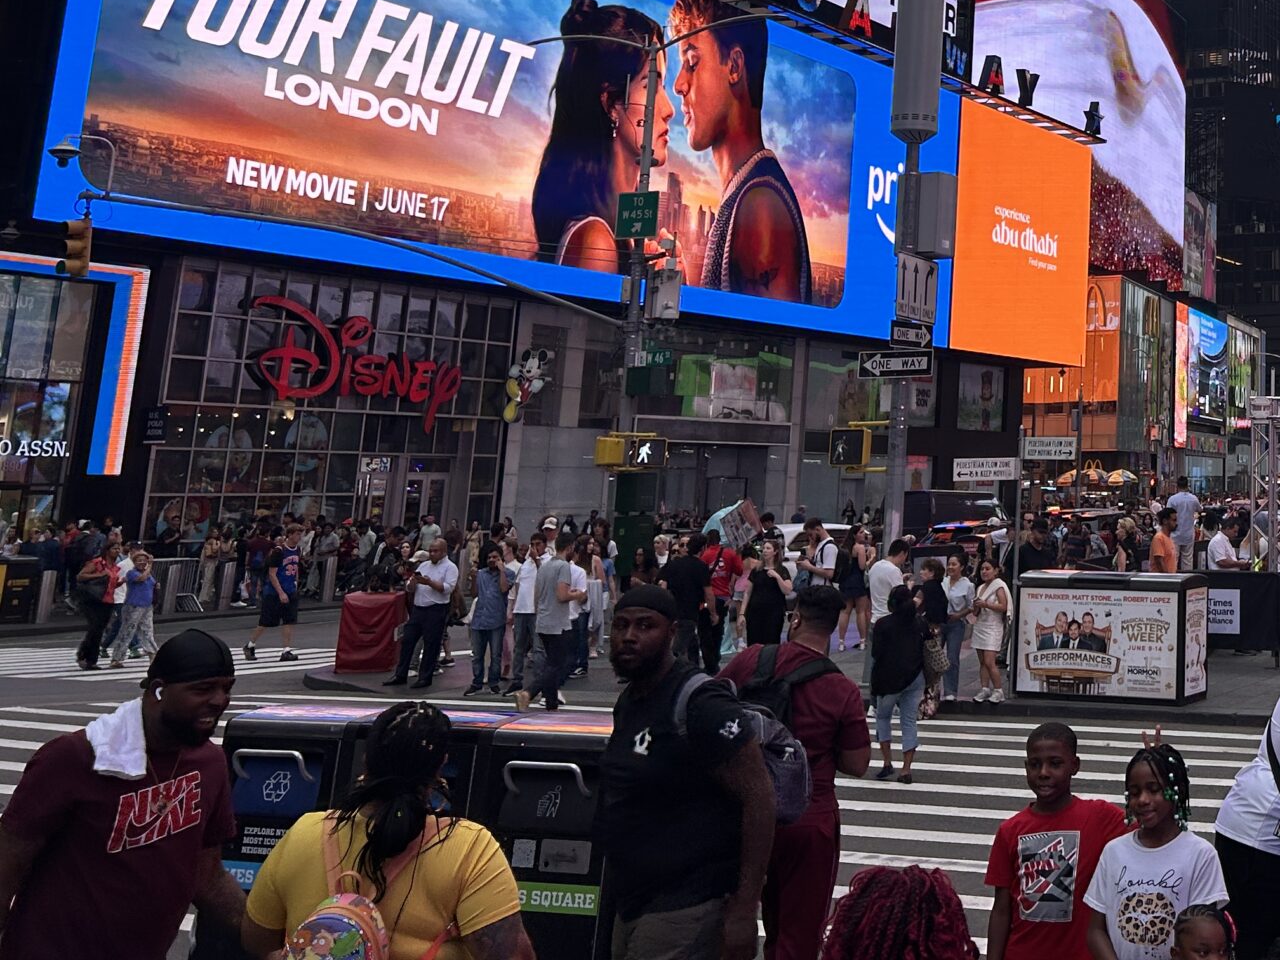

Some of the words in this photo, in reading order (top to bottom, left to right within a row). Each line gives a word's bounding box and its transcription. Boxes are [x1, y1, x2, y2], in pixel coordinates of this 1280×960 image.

[263, 66, 440, 136] LONDON
[225, 156, 285, 191] NEW
[284, 168, 358, 207] MOVIE
[374, 187, 427, 219] JUNE
[429, 195, 450, 222] 17
[633, 197, 644, 207] TO
[630, 210, 643, 219] 45
[994, 204, 1031, 225] experience
[992, 220, 1019, 248] abu
[896, 329, 910, 340] ONE
[914, 329, 928, 341] WAY
[654, 352, 664, 364] 46
[870, 359, 892, 371] ONE
[901, 358, 924, 370] WAY
[15, 440, 70, 458] ASSN.
[1028, 440, 1052, 448] PEDESTRIAN
[1052, 440, 1063, 448] FLOW
[1063, 440, 1074, 448] ZONE
[956, 461, 984, 469] PEDESTRIAN
[985, 461, 998, 469] FLOW
[998, 460, 1011, 468] ZONE
[1027, 593, 1044, 601] TREY
[1123, 595, 1148, 603] ROBERT
[1149, 596, 1171, 604] LOPEZ
[1207, 598, 1233, 607] Times
[1207, 607, 1235, 616] Square
[1120, 623, 1170, 634] MYSTERY
[1127, 632, 1164, 643] WEEK
[1039, 652, 1112, 665] PERFORMANCES
[107, 771, 201, 853] NIKE
[243, 826, 275, 836] EXPLORE
[242, 836, 263, 845] MOST
[531, 888, 596, 909] SQUARE
